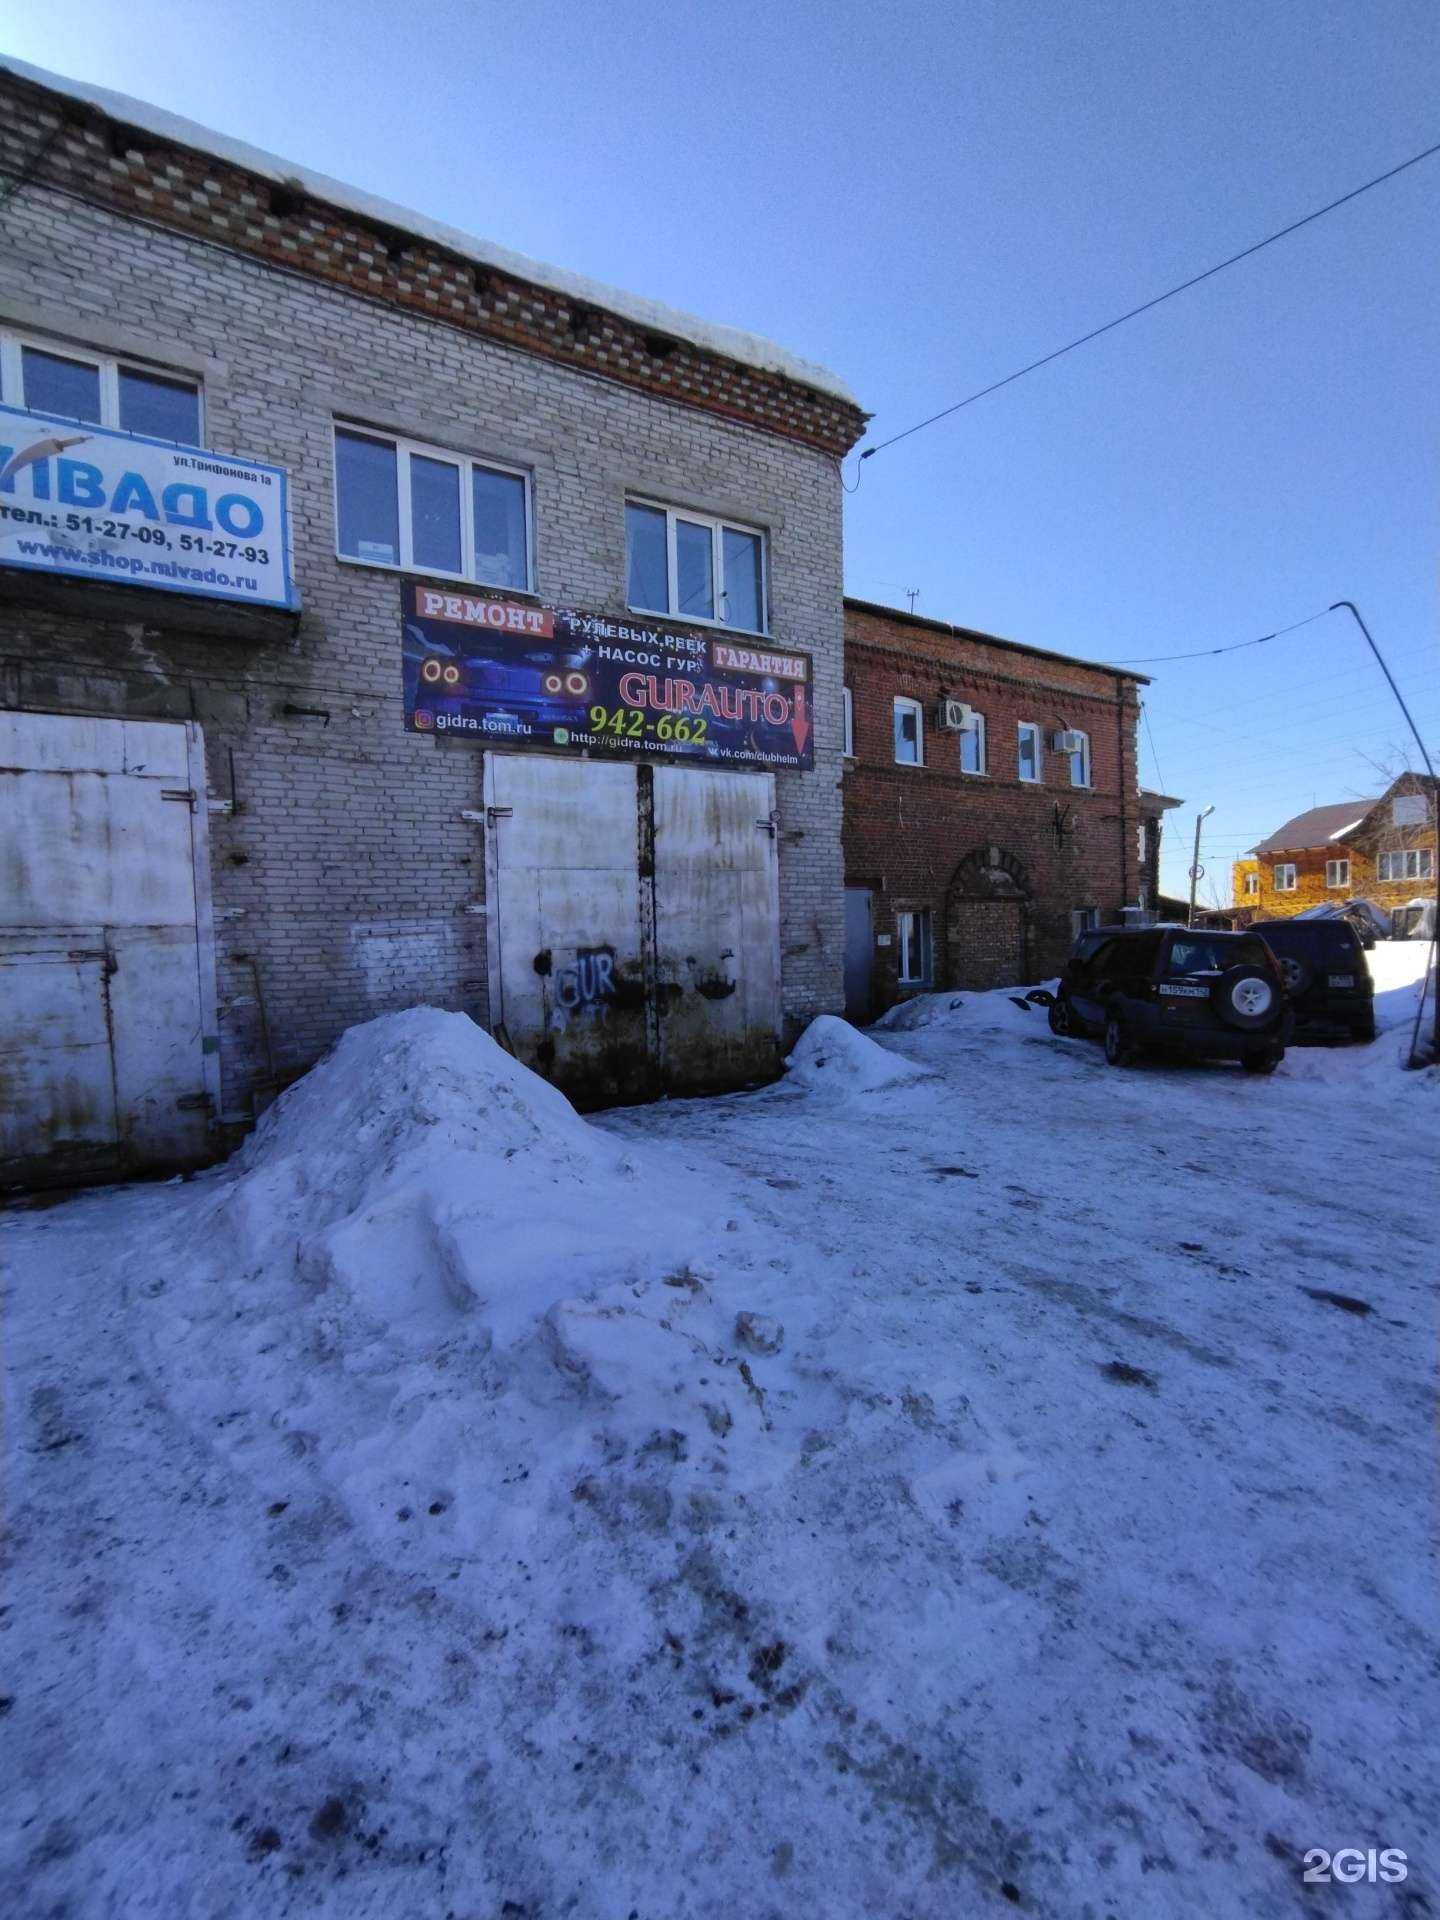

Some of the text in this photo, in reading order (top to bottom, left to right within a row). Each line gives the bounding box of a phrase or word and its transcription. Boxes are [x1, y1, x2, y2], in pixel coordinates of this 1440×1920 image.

[65, 513, 172, 551] 51-27-09,
[180, 535, 270, 565] 51-27-93
[17, 538, 258, 591] www.shop.mivado.ru
[423, 592, 544, 633] РЕМОНТ
[570, 616, 660, 645] РУЛЕВЫХ
[598, 645, 661, 667] НАСОС
[715, 647, 806, 678] ГАРАНТИЯ
[619, 672, 790, 725] GURAUTO
[436, 714, 532, 735] gidra.tom.ru
[571, 731, 682, 753] http://gidra.tom.ru
[589, 706, 708, 746] 942-662
